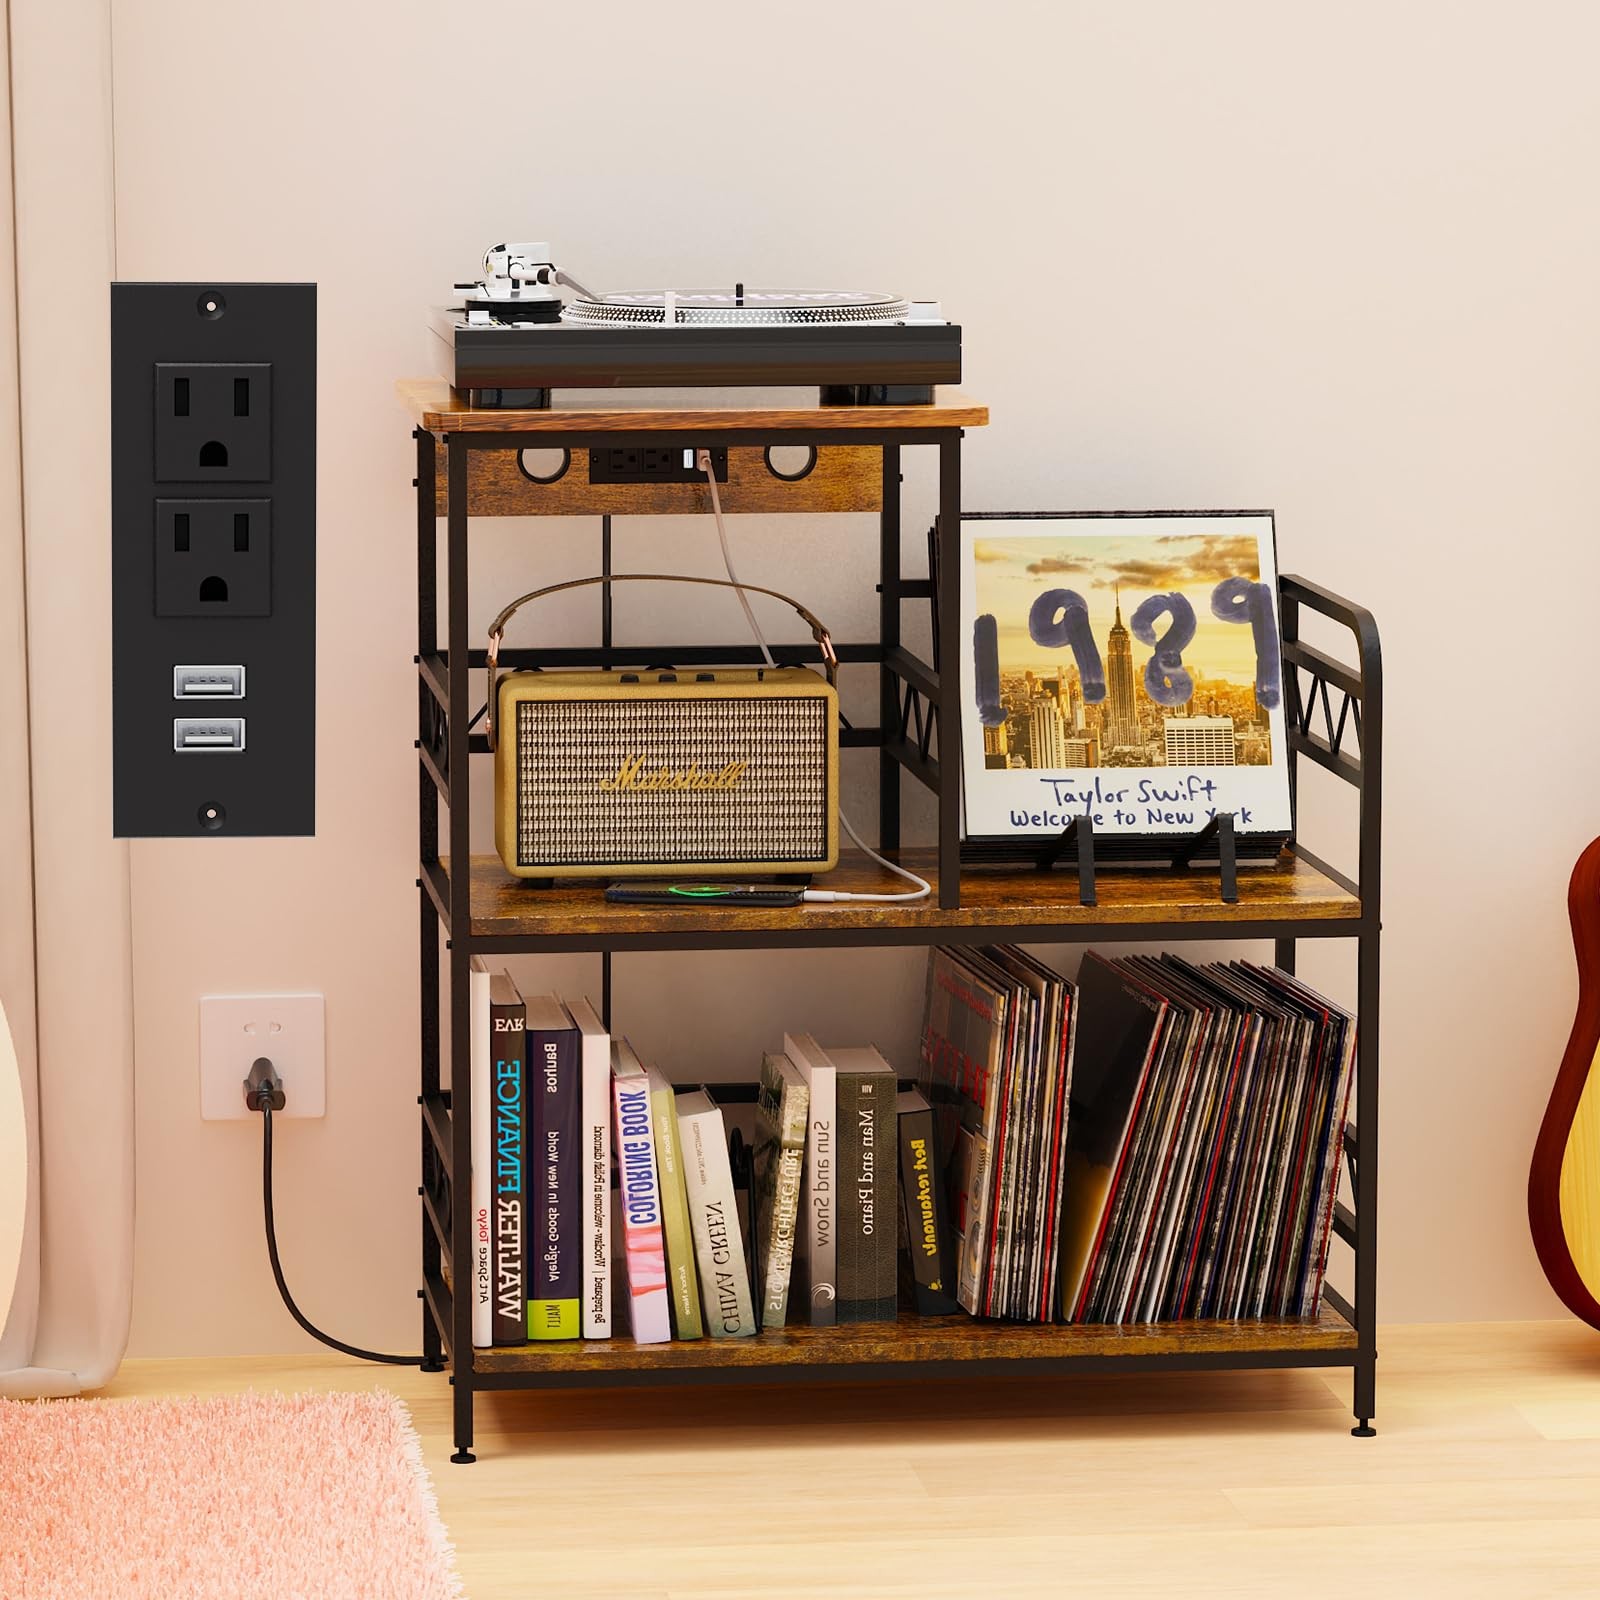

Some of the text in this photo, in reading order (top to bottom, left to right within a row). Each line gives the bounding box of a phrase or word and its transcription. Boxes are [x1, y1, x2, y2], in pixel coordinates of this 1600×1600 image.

[973, 576, 1280, 727] 1989
[600, 754, 747, 790] Marshall
[1040, 775, 1217, 816] Taylor Swift
[1010, 810, 1104, 826] Welcoe
[1113, 810, 1136, 825] to
[1147, 808, 1194, 825] New
